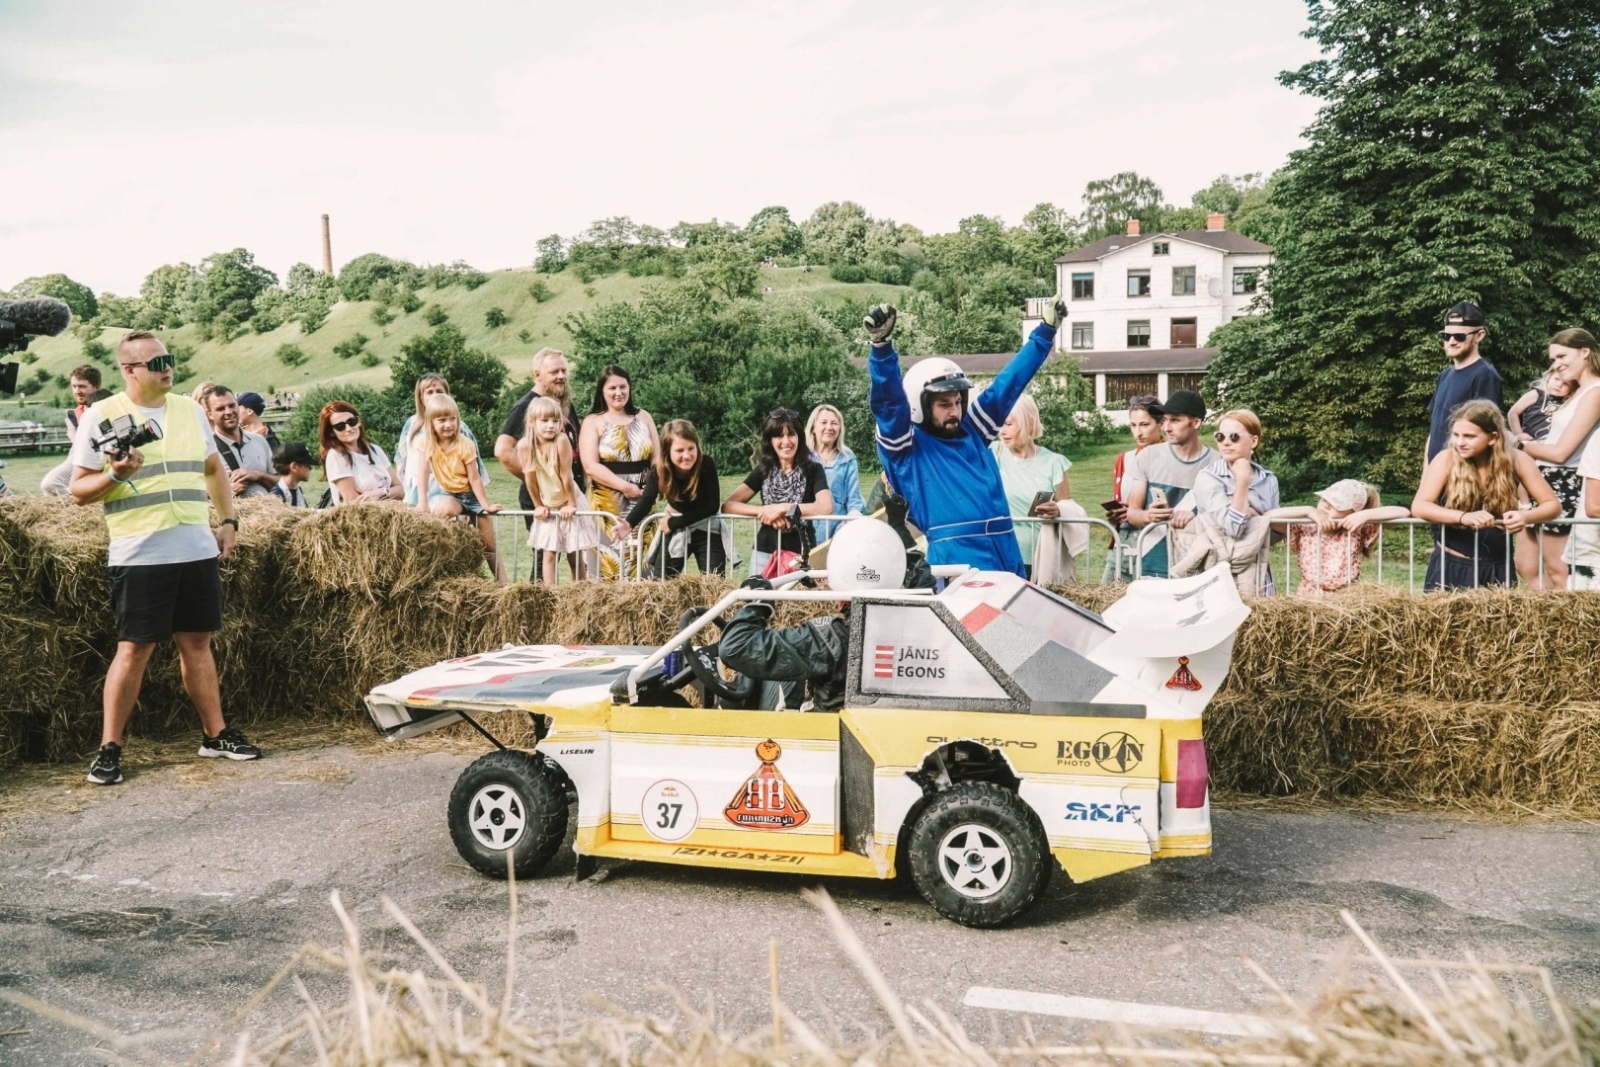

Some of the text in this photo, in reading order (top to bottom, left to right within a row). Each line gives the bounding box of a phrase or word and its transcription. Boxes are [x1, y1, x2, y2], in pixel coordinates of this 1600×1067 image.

[898, 646, 939, 662] JĀNIS
[897, 666, 945, 678] EGONS
[1057, 759, 1091, 767] PHOTO
[656, 802, 683, 829] 37
